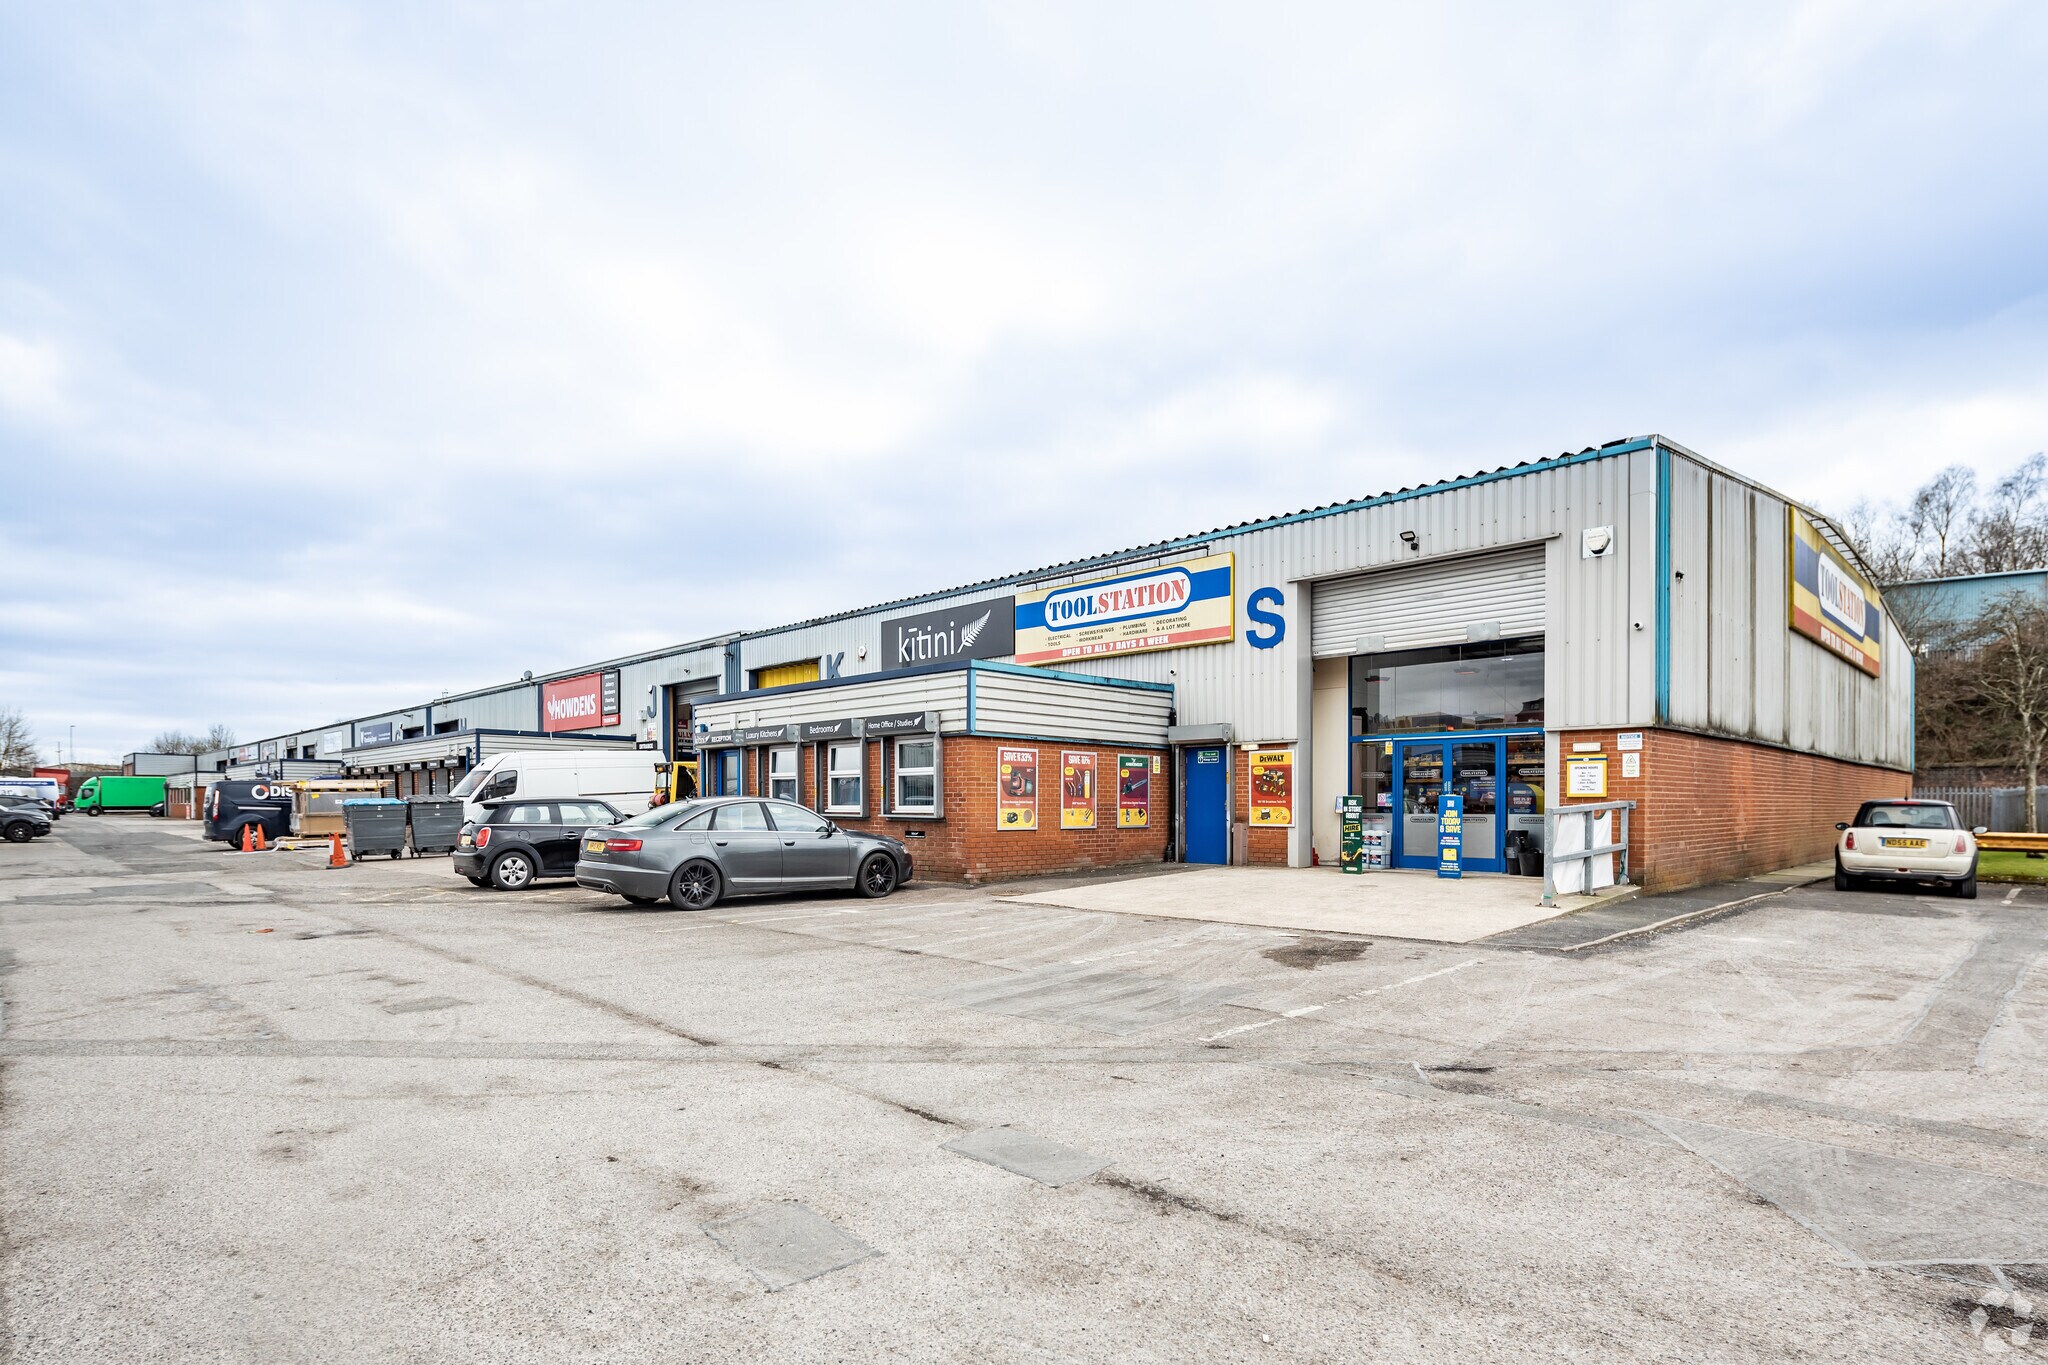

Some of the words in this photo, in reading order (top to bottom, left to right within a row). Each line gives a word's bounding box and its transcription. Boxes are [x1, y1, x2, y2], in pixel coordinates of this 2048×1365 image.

[1049, 578, 1186, 622] TOOLSTATION
[1821, 564, 1864, 627] TOOLSTATION
[1156, 616, 1188, 625] DECORATING
[1246, 586, 1286, 650] S
[1122, 622, 1147, 630] PLUMBING
[1047, 633, 1072, 641] ELECTRICAL
[1062, 648, 1080, 656] OPEN
[1083, 646, 1092, 654] TO
[1094, 644, 1107, 653] ALL
[1108, 642, 1113, 650] 7
[1116, 640, 1136, 650] DAYS
[1139, 638, 1145, 647] A
[1147, 635, 1169, 645] WEEK
[827, 651, 845, 680] K
[555, 694, 596, 719] HOWDENS
[647, 685, 657, 718] J
[881, 720, 893, 728] Office
[897, 718, 914, 727] Studies
[745, 731, 759, 741] Luxury
[759, 728, 778, 739] Kitchens
[809, 725, 834, 735] Bedrooms
[711, 735, 732, 743] RECEPTION
[1003, 752, 1017, 761] SAVE
[1068, 755, 1081, 764] SAVE
[1440, 817, 1461, 826] TODAY
[1344, 824, 1360, 832] HIRE
[1445, 825, 1462, 834] SAVE
